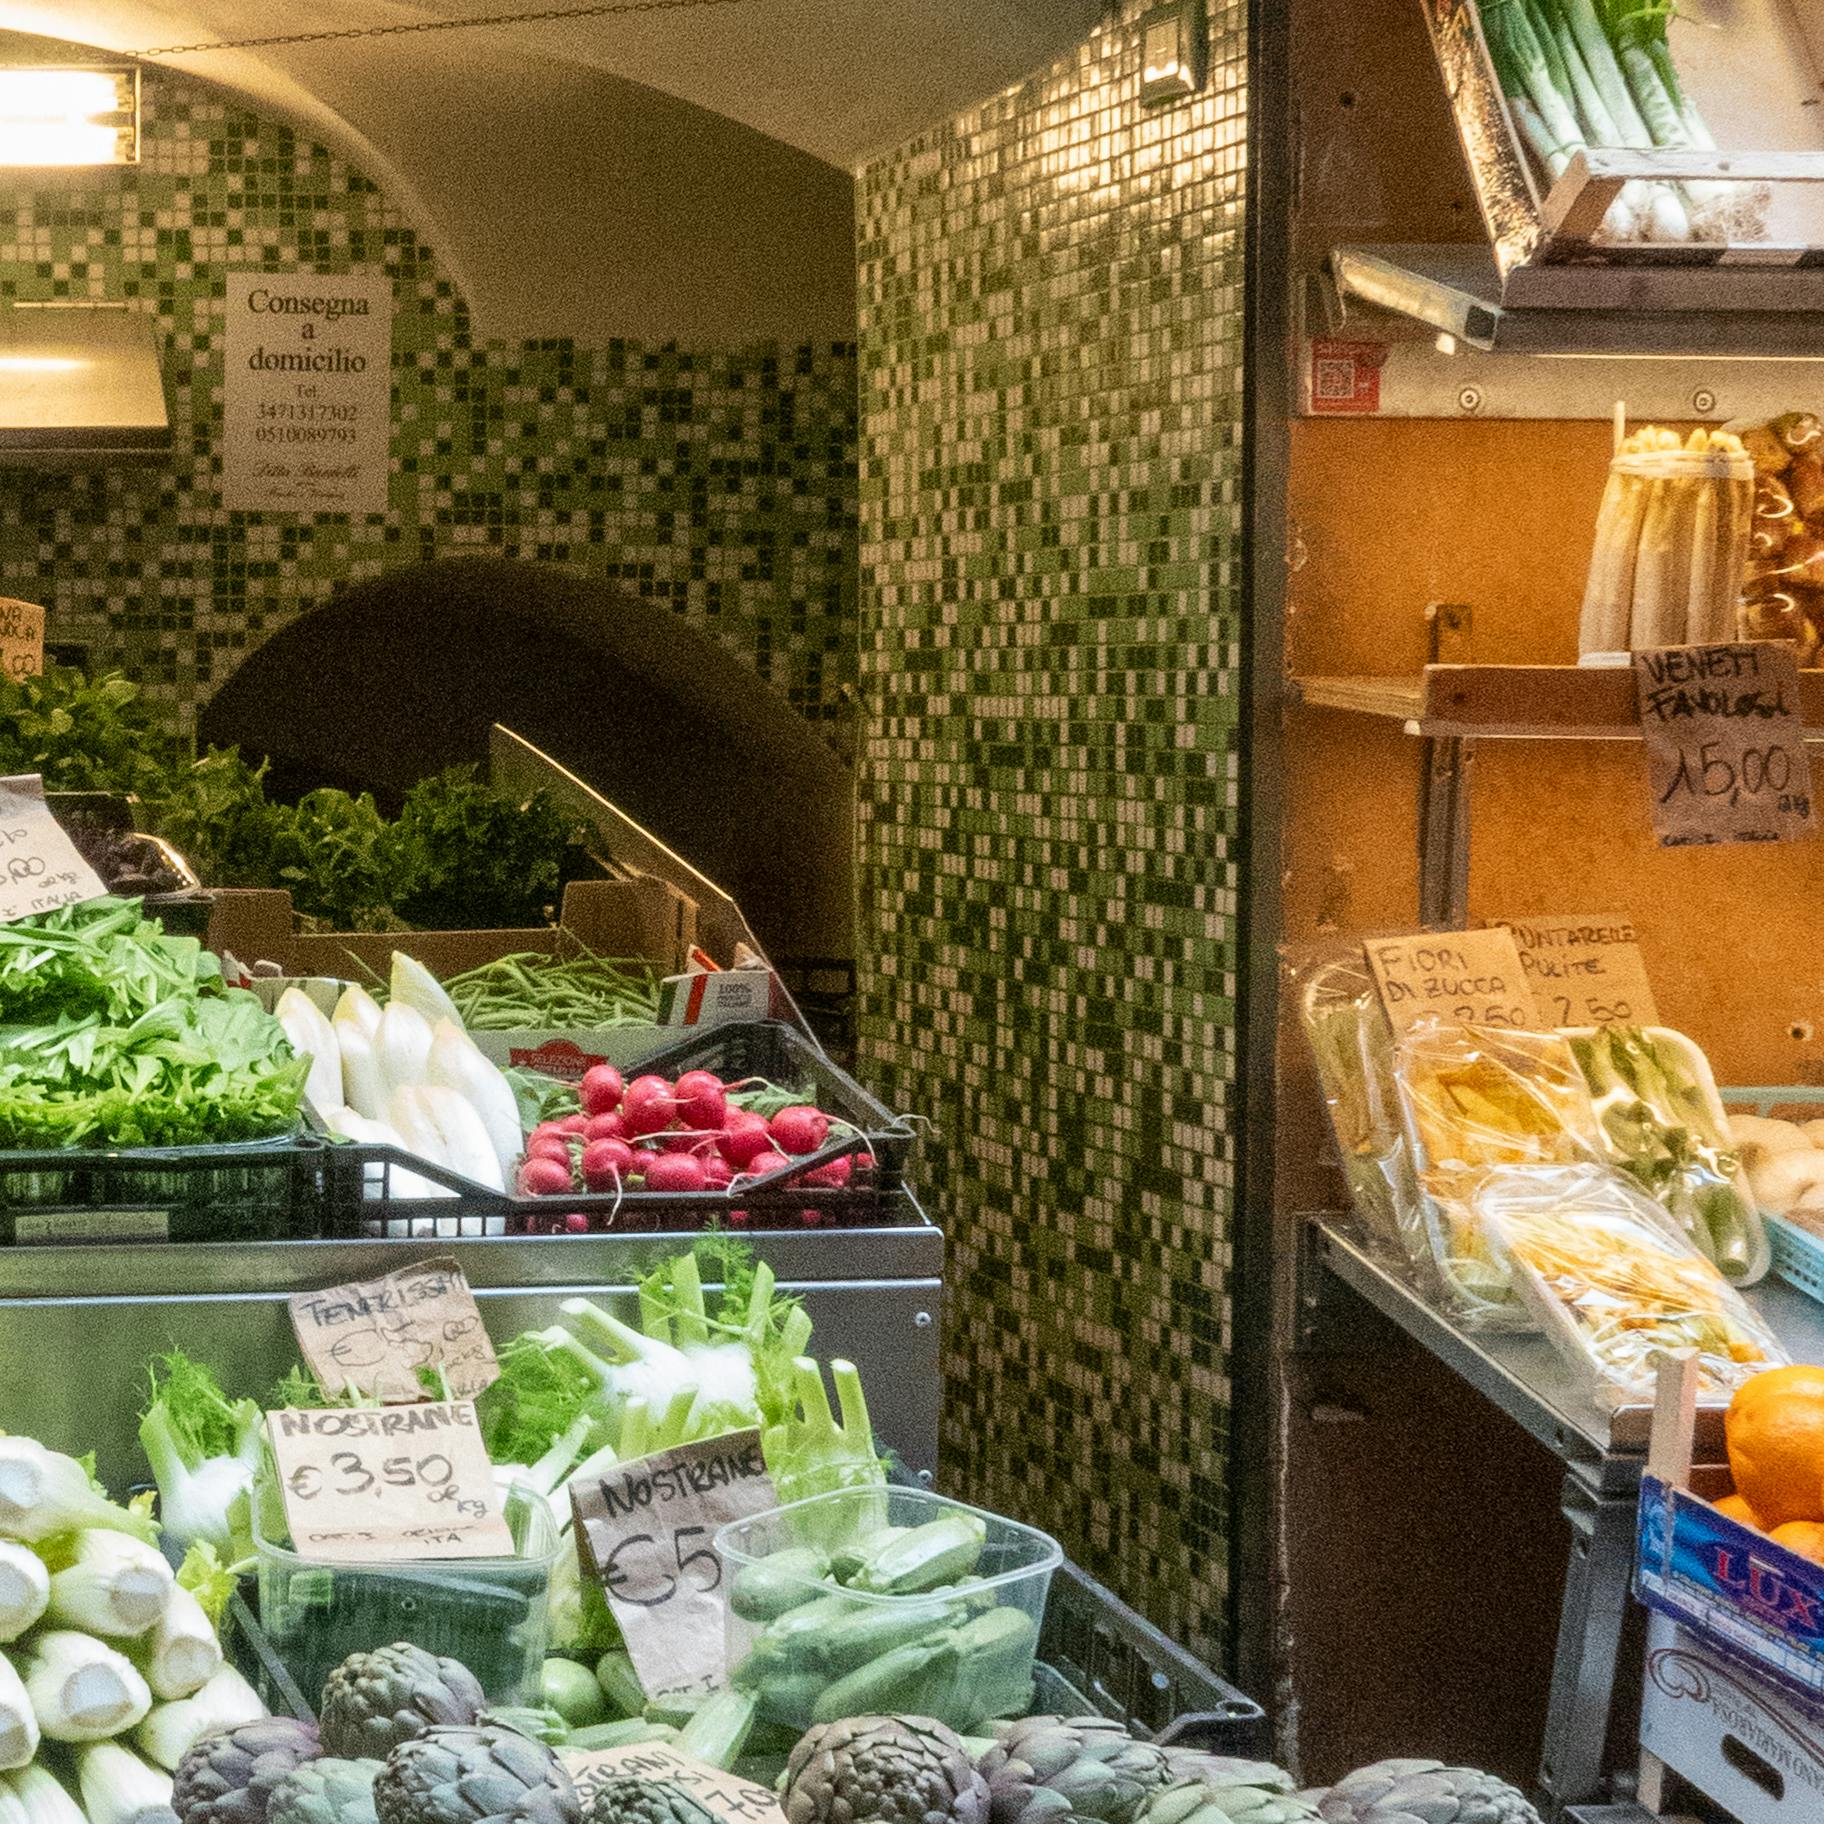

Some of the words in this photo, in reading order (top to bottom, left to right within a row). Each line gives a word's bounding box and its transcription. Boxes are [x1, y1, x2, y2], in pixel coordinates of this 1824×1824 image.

[247, 288, 370, 321] Consegna
[301, 322, 315, 339] a
[248, 346, 367, 374] domicilio
[1659, 740, 1791, 808] 15,00
[1377, 945, 1469, 976] FIORI
[1424, 976, 1507, 999] ZUCCA
[279, 1403, 474, 1438] NOSTRANE
[598, 1442, 767, 1519] NOSTRANE
